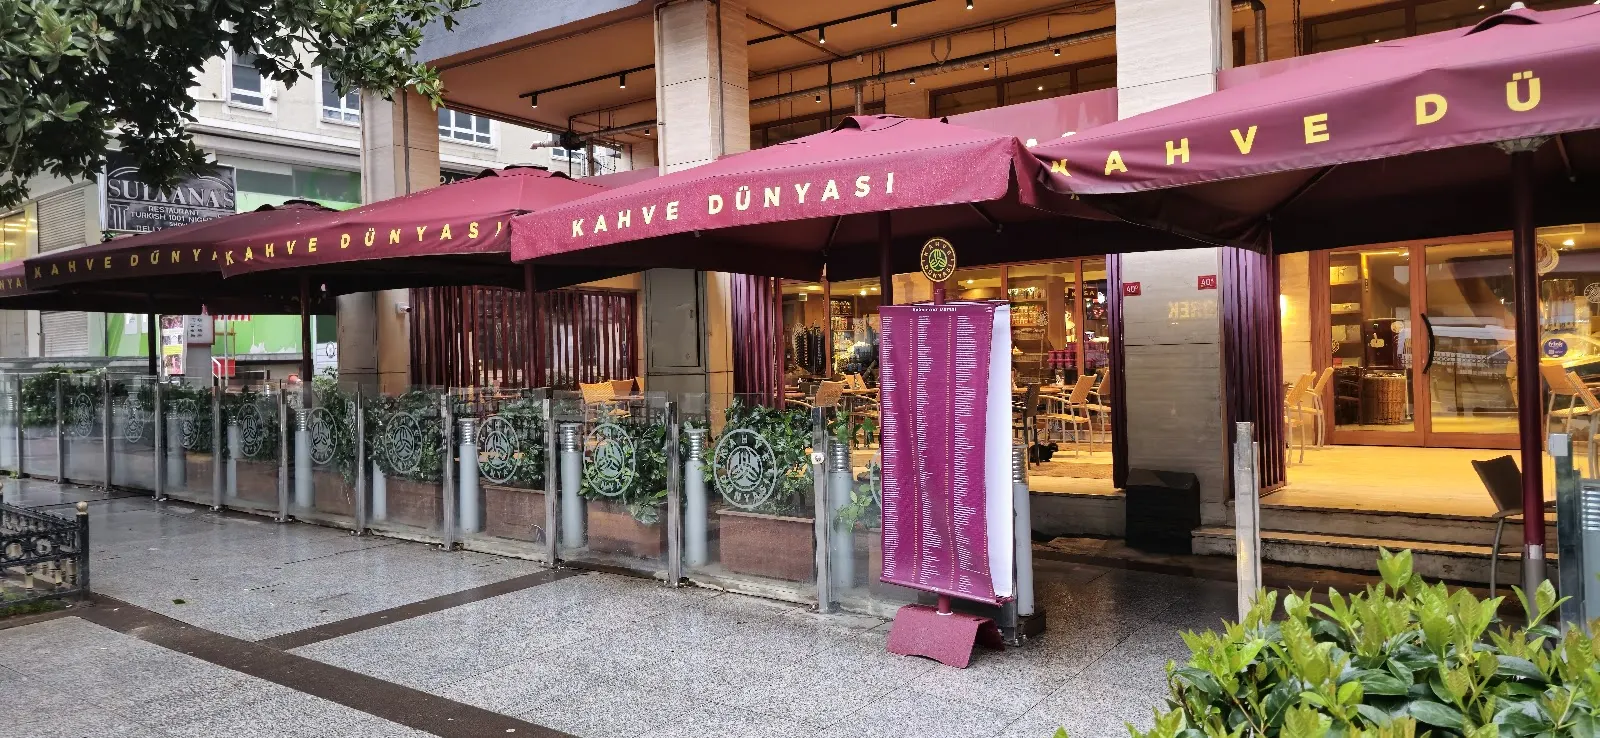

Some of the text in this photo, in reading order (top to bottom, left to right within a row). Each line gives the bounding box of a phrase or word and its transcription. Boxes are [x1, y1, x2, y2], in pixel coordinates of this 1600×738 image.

[1051, 113, 1330, 177] KAHVE
[131, 211, 166, 220] TURKISH
[168, 214, 185, 222] 1001
[148, 206, 200, 216] RESTAURANT
[572, 173, 895, 238] KAHVE DÜNYASI
[225, 221, 502, 266] KAHVE DÜNYASI
[34, 256, 112, 279] KAHVE
